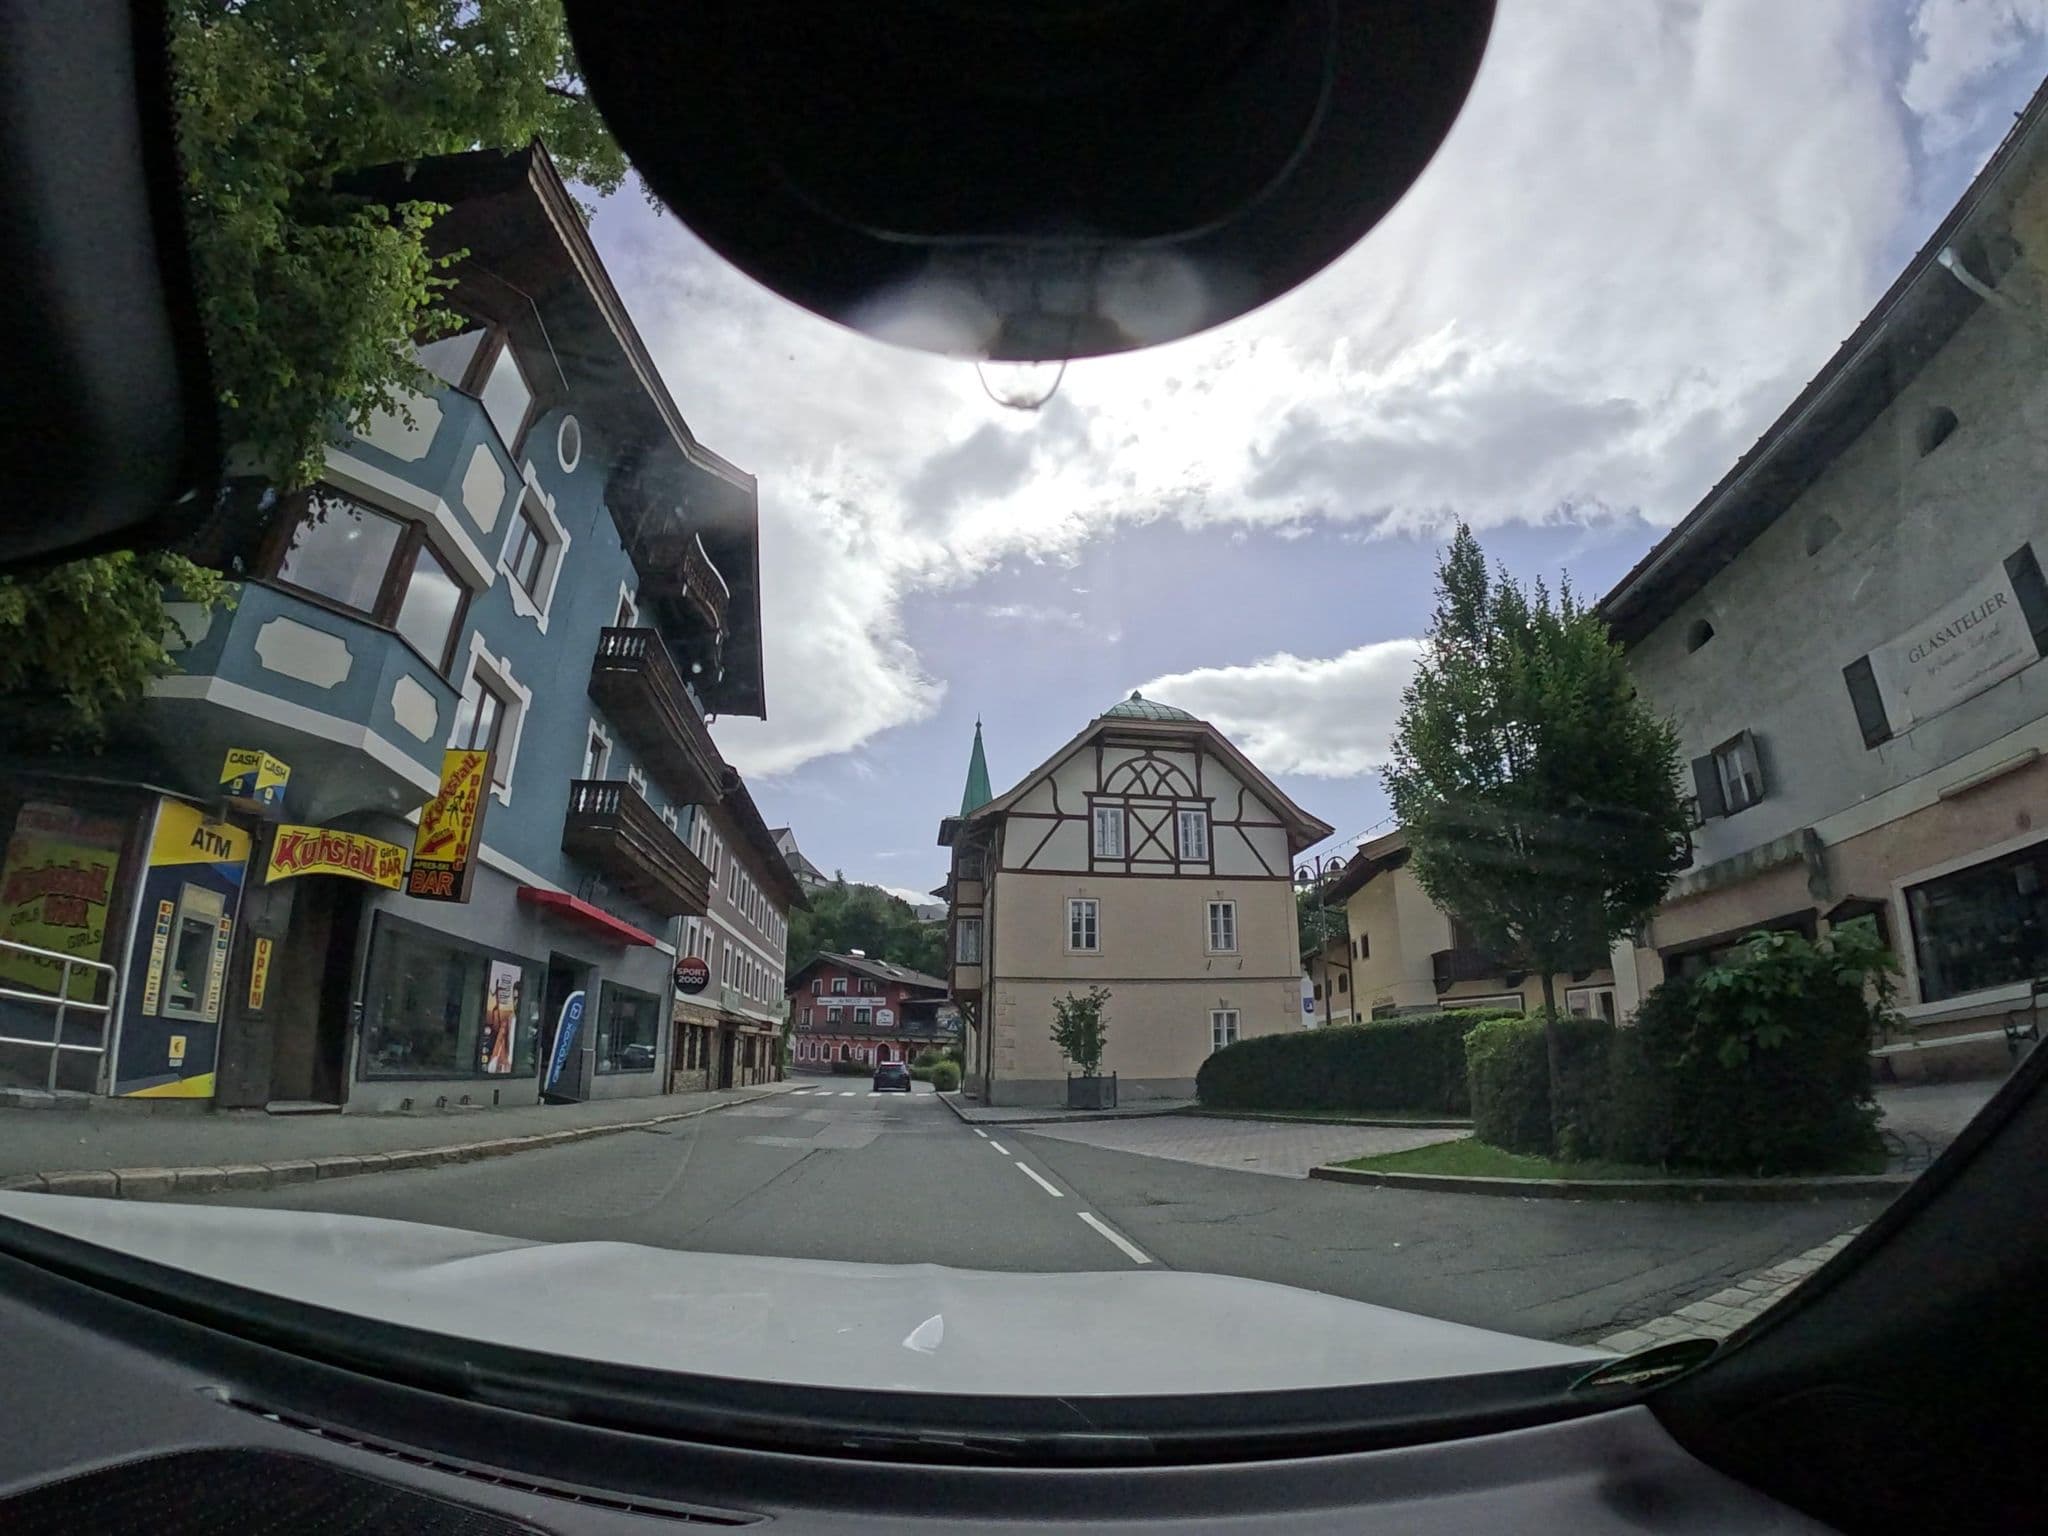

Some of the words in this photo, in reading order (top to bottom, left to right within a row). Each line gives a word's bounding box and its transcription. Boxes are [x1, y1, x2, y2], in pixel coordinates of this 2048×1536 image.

[1908, 592, 2008, 664] GLASATELIER
[229, 753, 260, 766] CASH
[264, 760, 286, 778] CASH
[452, 774, 481, 871] DANCING
[191, 827, 232, 859] ATM
[272, 830, 378, 879] Kuhstall
[379, 856, 401, 879] BAR
[409, 869, 455, 896] BAR
[67, 929, 102, 949] GIRLS
[251, 939, 268, 1007] OPEN
[677, 967, 707, 977] SPORT
[678, 976, 704, 985] 2000
